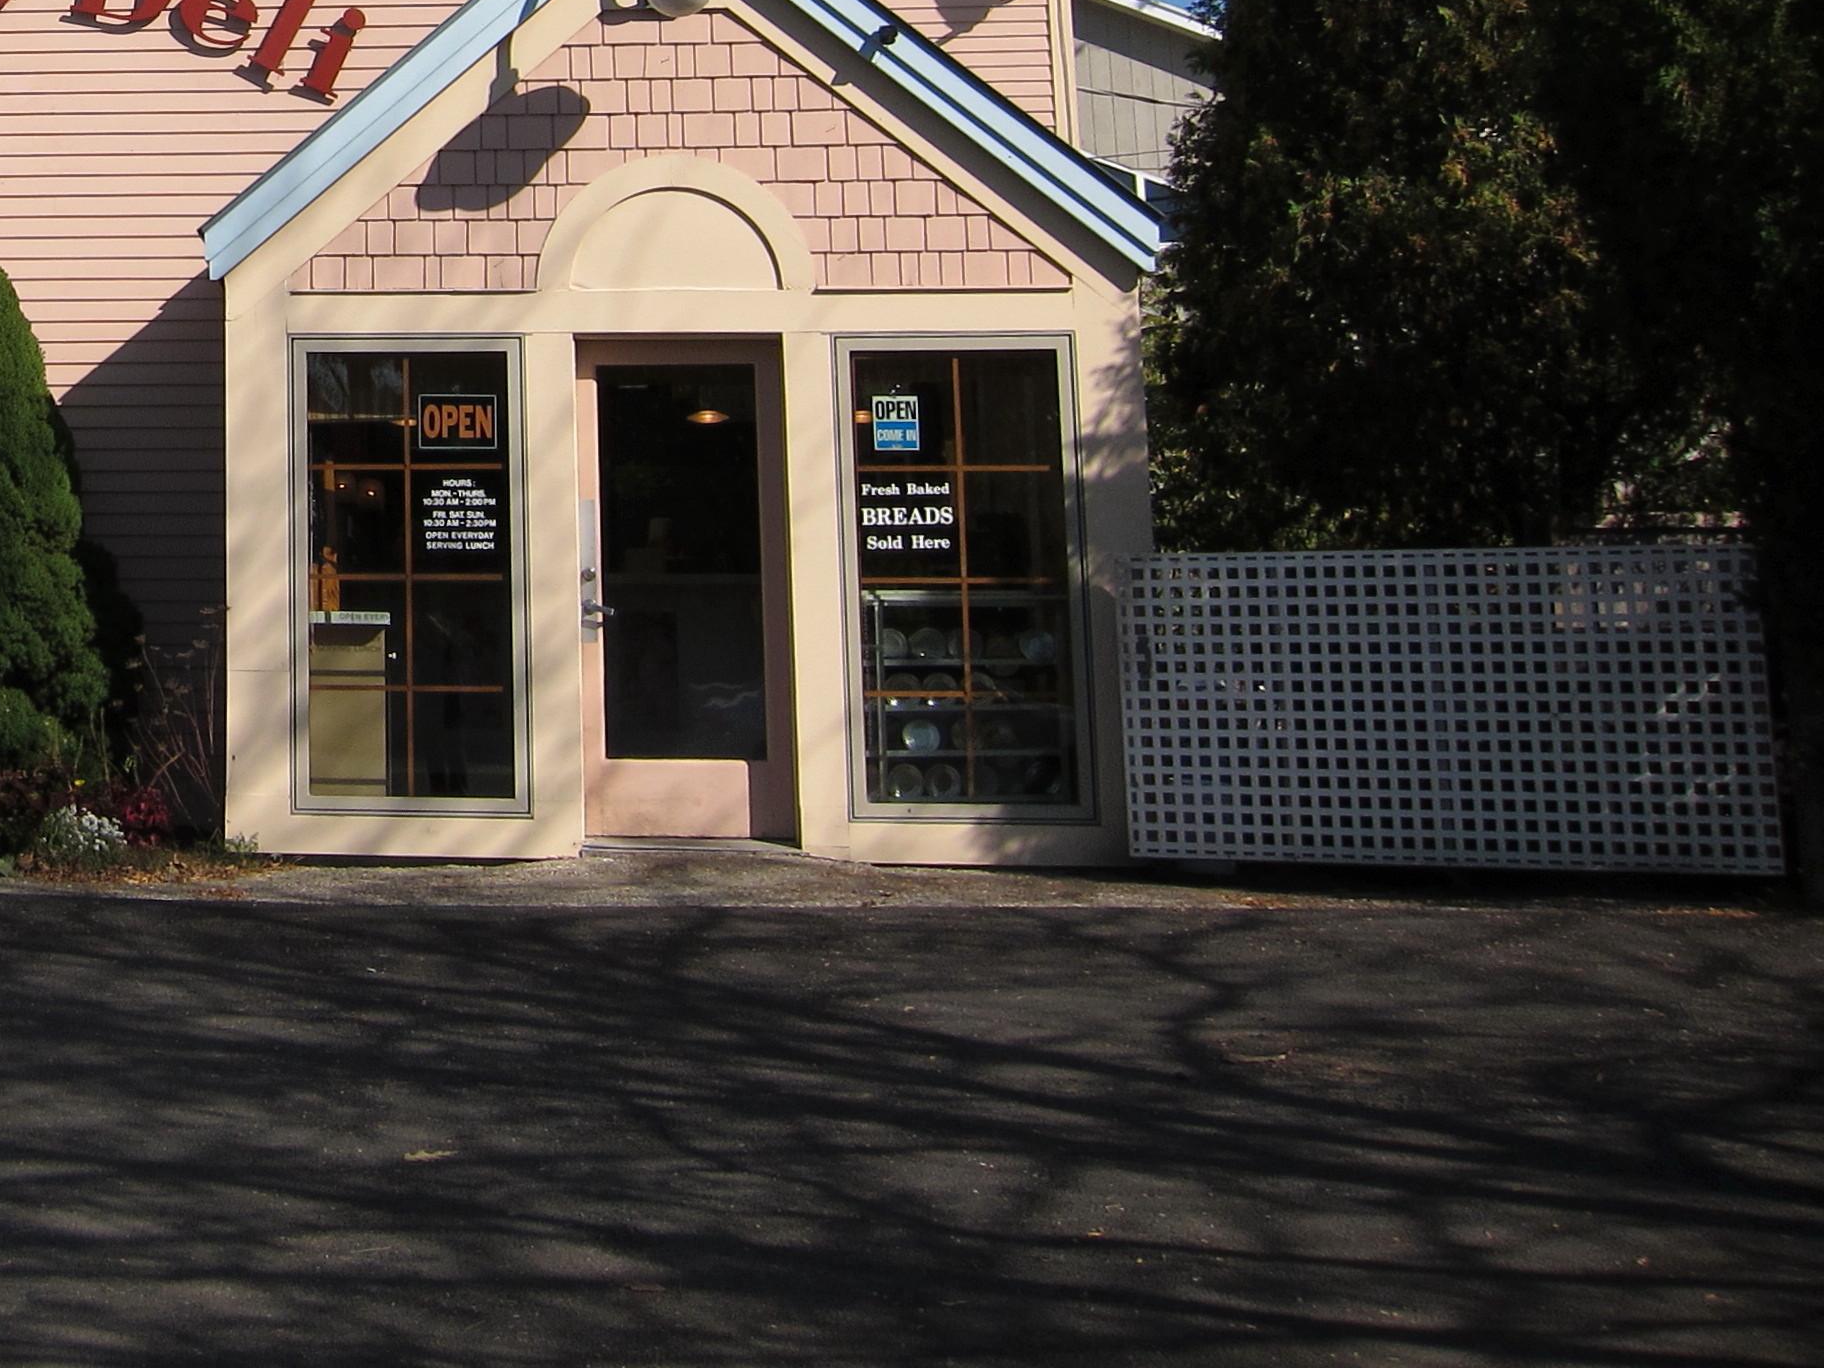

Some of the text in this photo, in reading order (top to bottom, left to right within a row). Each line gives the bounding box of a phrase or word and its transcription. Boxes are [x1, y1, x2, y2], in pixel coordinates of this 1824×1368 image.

[876, 400, 917, 420] OPEN
[423, 404, 493, 439] OPEN
[877, 429, 917, 441] COME IN
[861, 482, 950, 496] Fresh Baked
[423, 498, 445, 506] 10:30
[446, 498, 459, 506] AM
[861, 506, 954, 526] BREADS
[446, 519, 459, 527] AM
[425, 531, 495, 540] OPEN EVERYDAY
[426, 541, 495, 550] SERVING LUNCH
[866, 535, 951, 550] Sold Here
